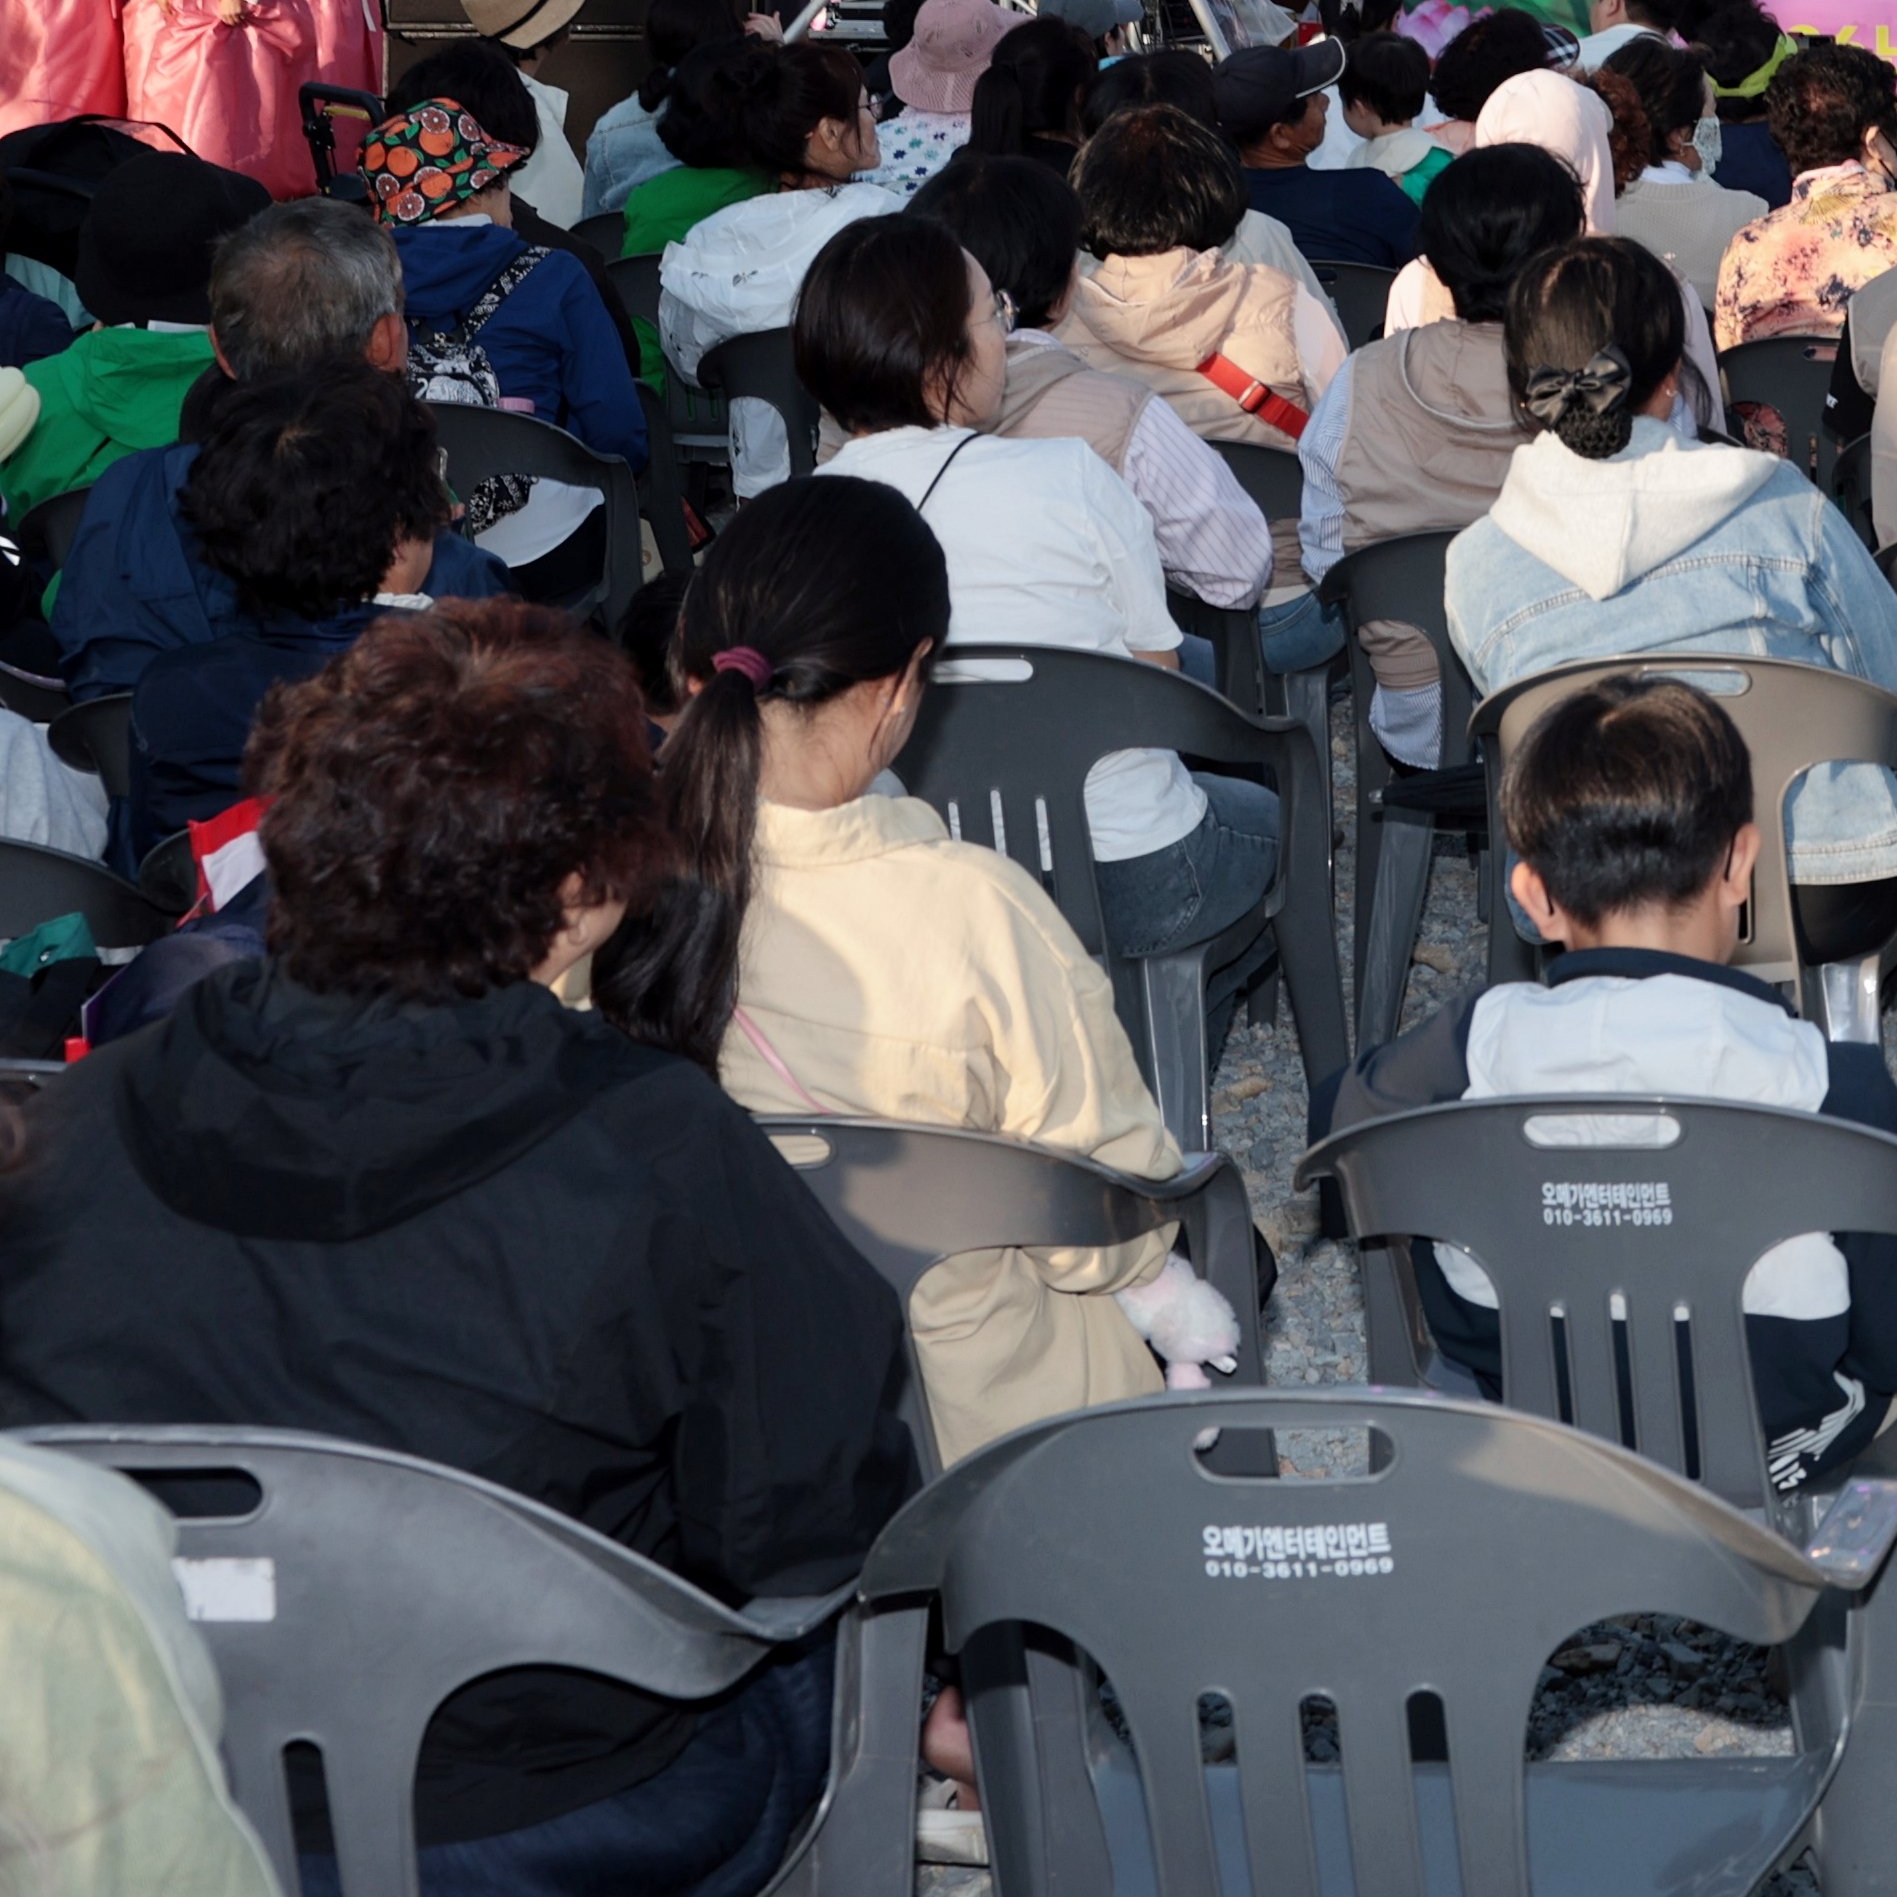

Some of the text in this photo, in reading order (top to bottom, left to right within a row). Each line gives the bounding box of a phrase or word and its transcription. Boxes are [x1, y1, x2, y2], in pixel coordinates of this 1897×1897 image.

[1541, 1181, 1672, 1209] 오메가엔터테인먼트
[1543, 1207, 1674, 1226] 010-3611-0969
[1202, 1522, 1392, 1560] 오메가엔터테인먼트
[1205, 1556, 1394, 1578] 010-3611-0969
